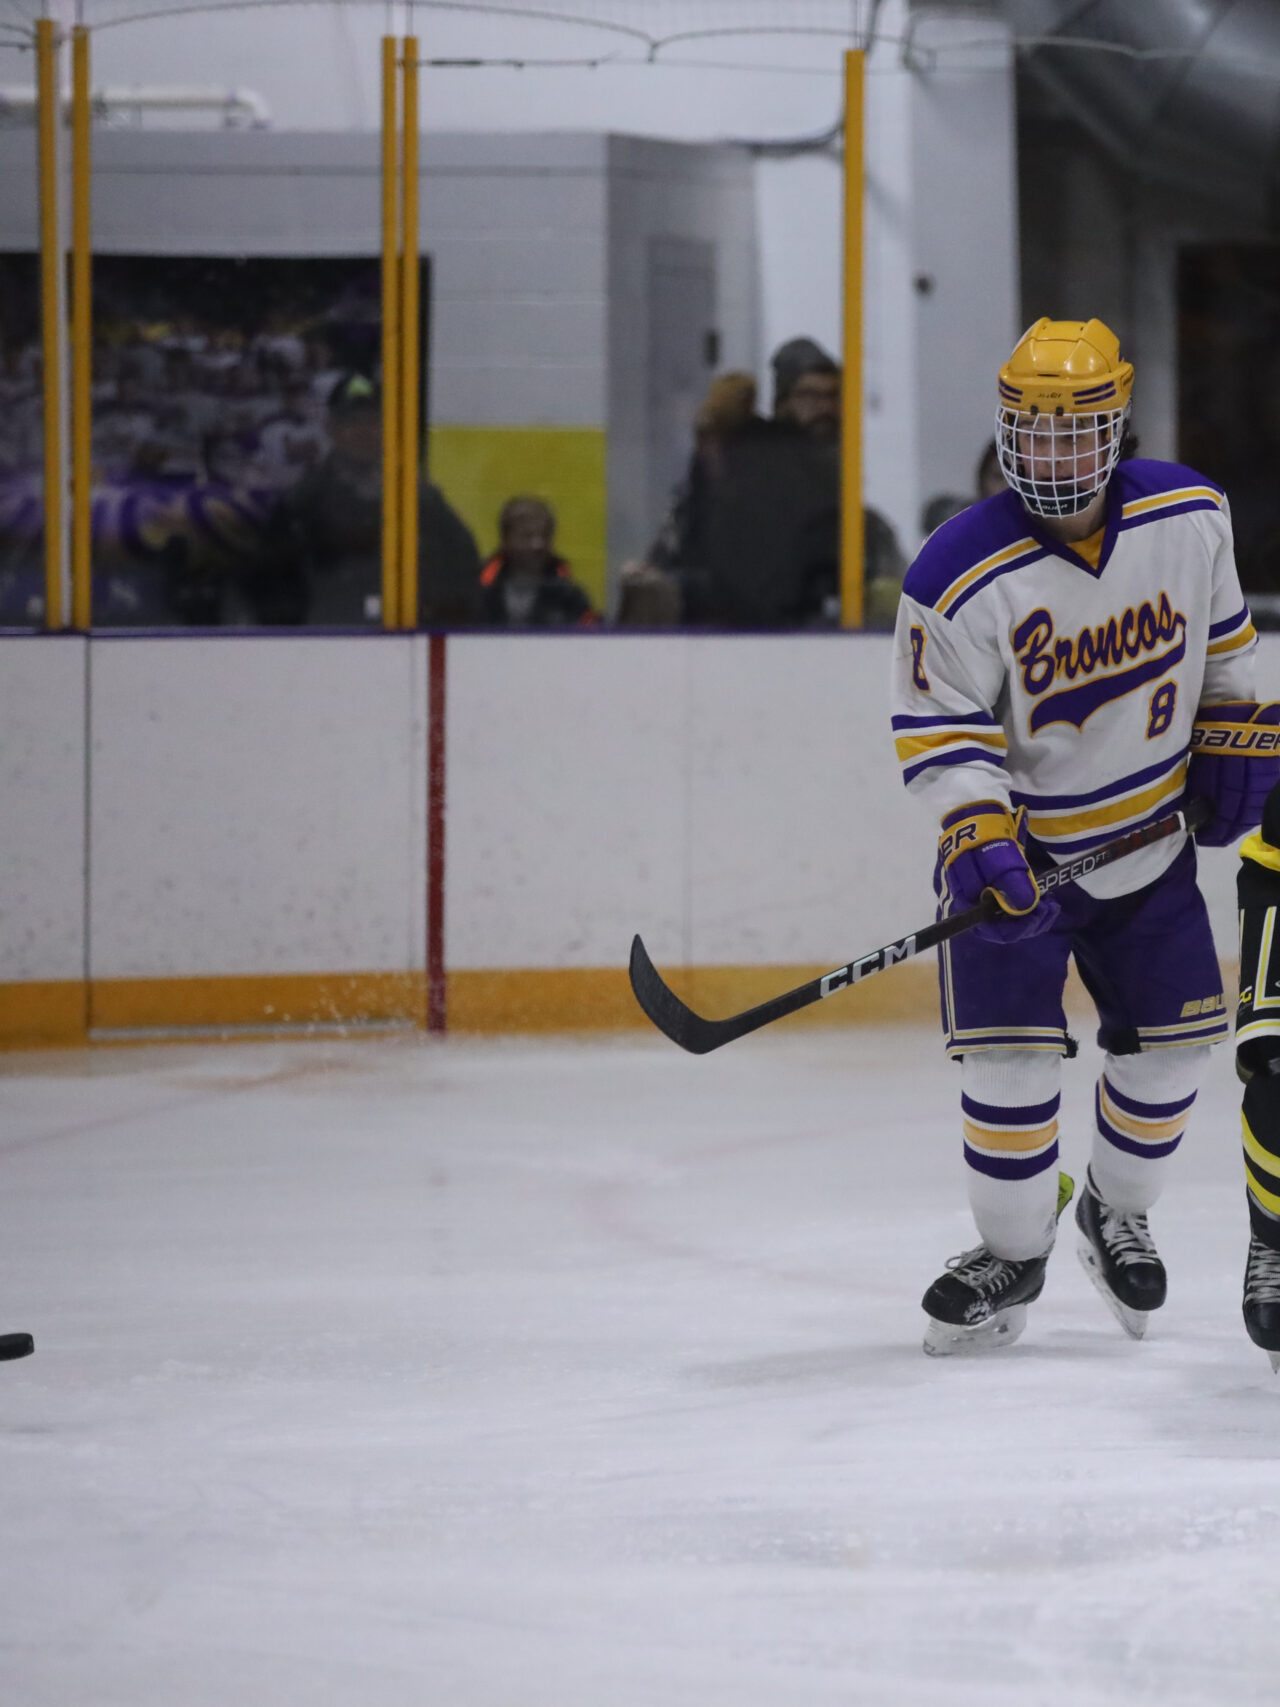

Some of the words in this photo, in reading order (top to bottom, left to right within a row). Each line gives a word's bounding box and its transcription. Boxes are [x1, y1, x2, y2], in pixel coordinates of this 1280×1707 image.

[1013, 590, 1187, 698] Broncos
[1145, 678, 1179, 741] 8
[1036, 855, 1096, 894] SPEED
[820, 935, 917, 1000] CCM
